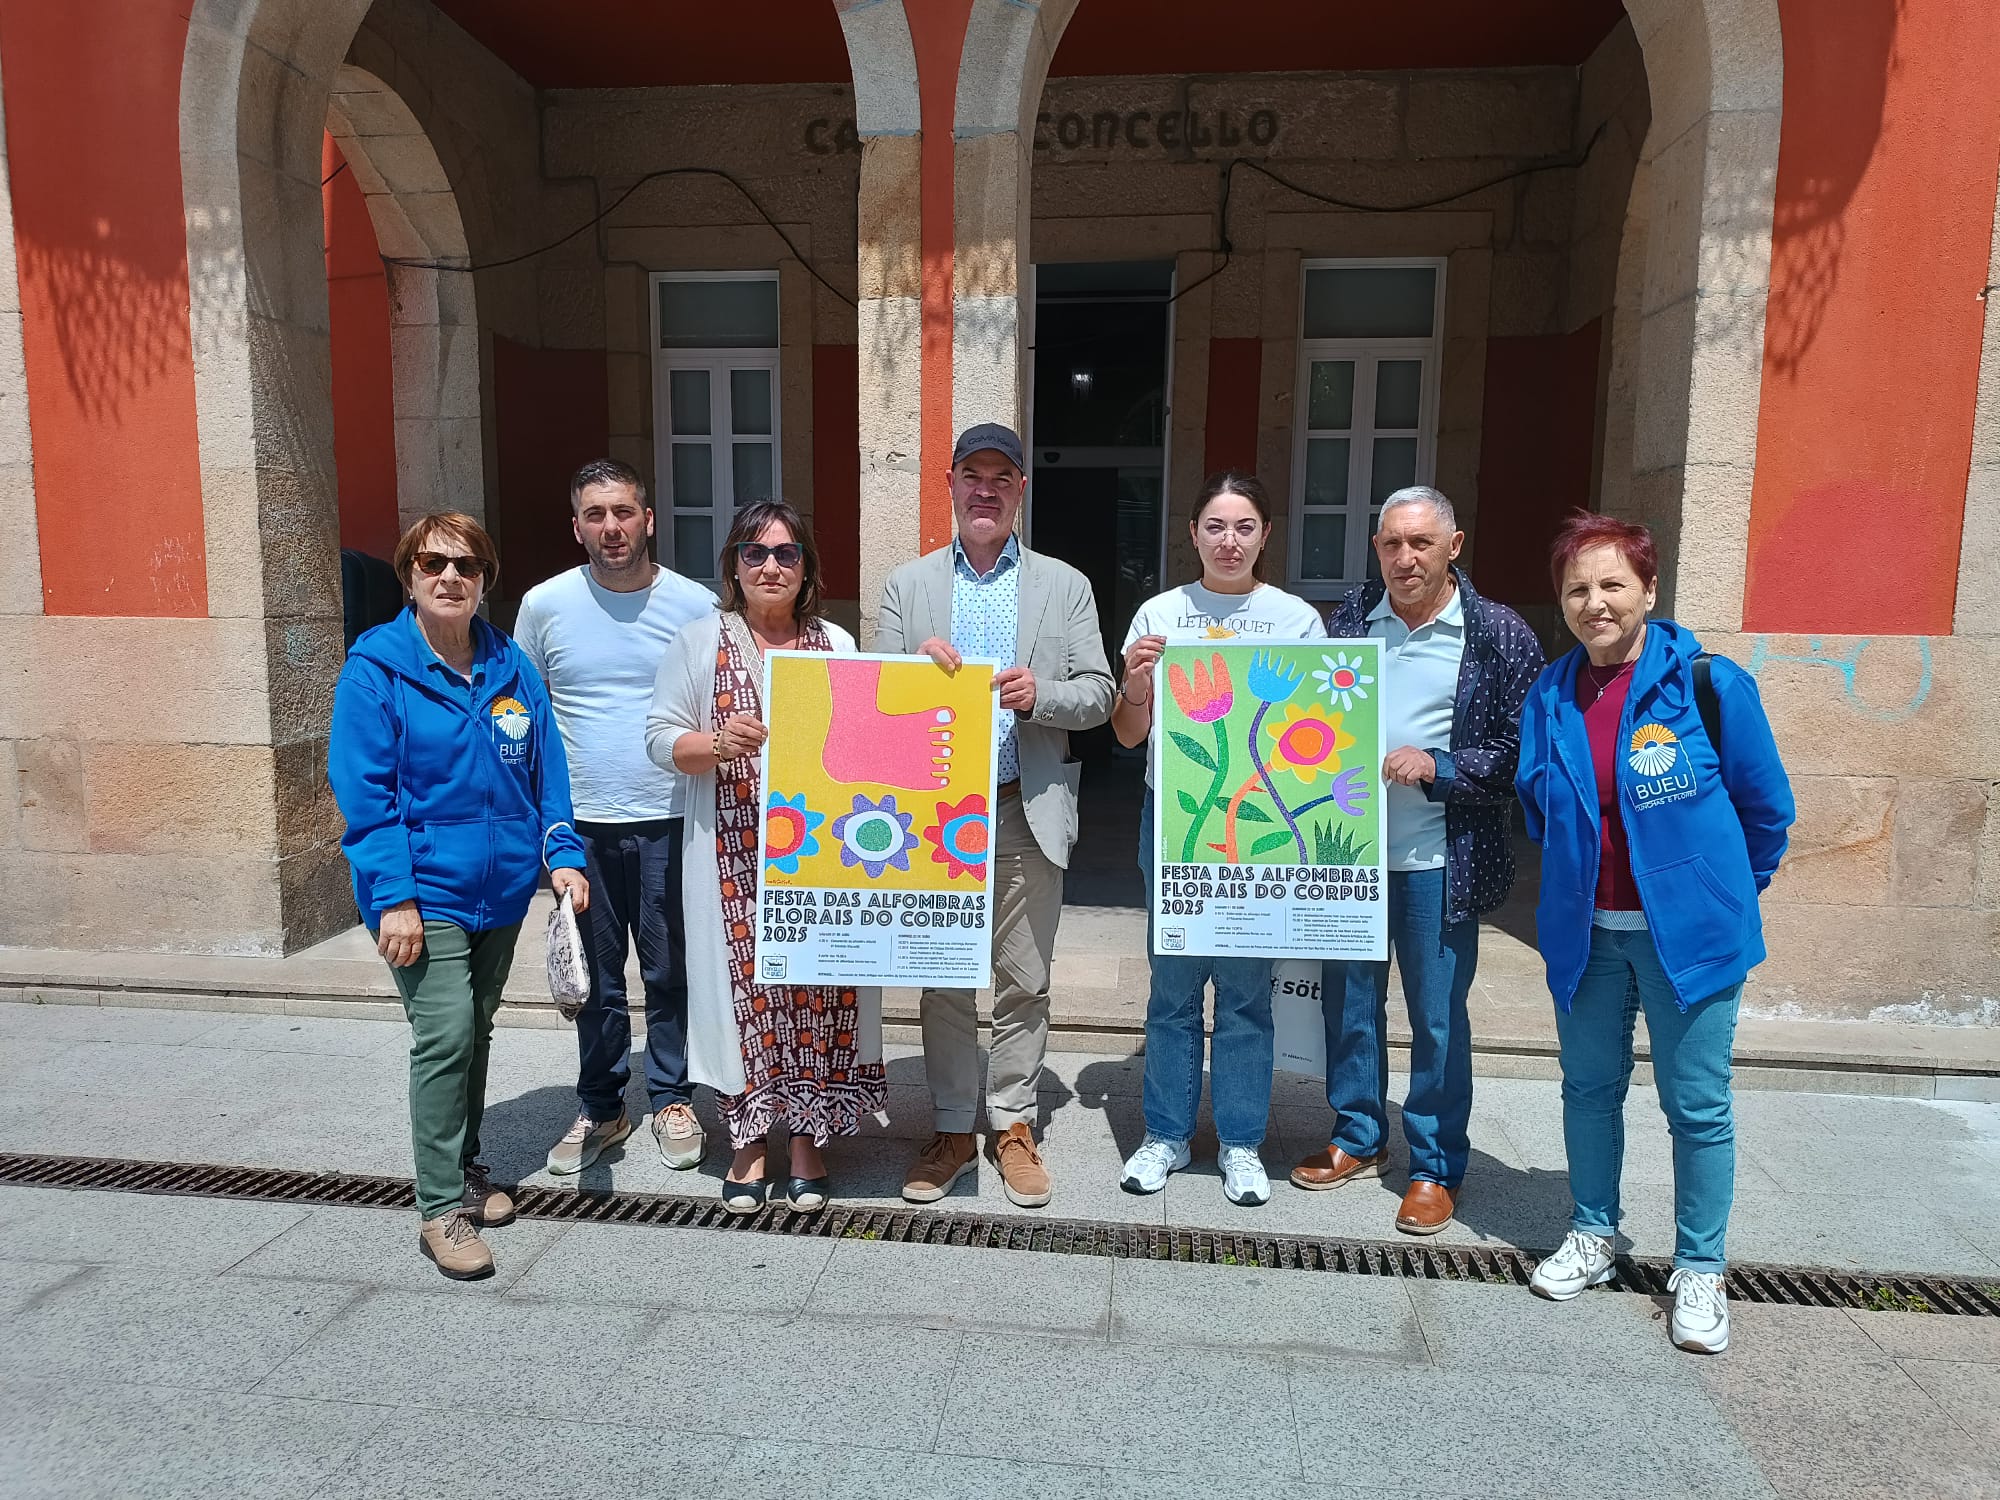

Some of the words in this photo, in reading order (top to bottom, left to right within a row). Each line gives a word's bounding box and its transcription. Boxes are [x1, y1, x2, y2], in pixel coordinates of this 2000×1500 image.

[1177, 616, 1195, 628] LE
[1198, 616, 1275, 634] BOUQUET
[1635, 774, 1689, 799] BUEU
[1161, 865, 1212, 880] FESTA
[1218, 866, 1255, 881] DAS
[1261, 867, 1379, 884] ALFOMBRAS
[764, 890, 817, 906] FESTA
[824, 891, 861, 908] DAS
[868, 893, 986, 911] ALFOMBRAS
[1161, 882, 1247, 899] FLORAIS
[1255, 883, 1286, 900] DO
[1294, 884, 1379, 901] CORPUS
[1161, 900, 1204, 915] 2025
[763, 908, 853, 926] FLORAIS
[860, 910, 893, 927] DO
[900, 911, 985, 929] CORPUS
[762, 926, 808, 943] 2025
[1282, 979, 1320, 1000] söt
